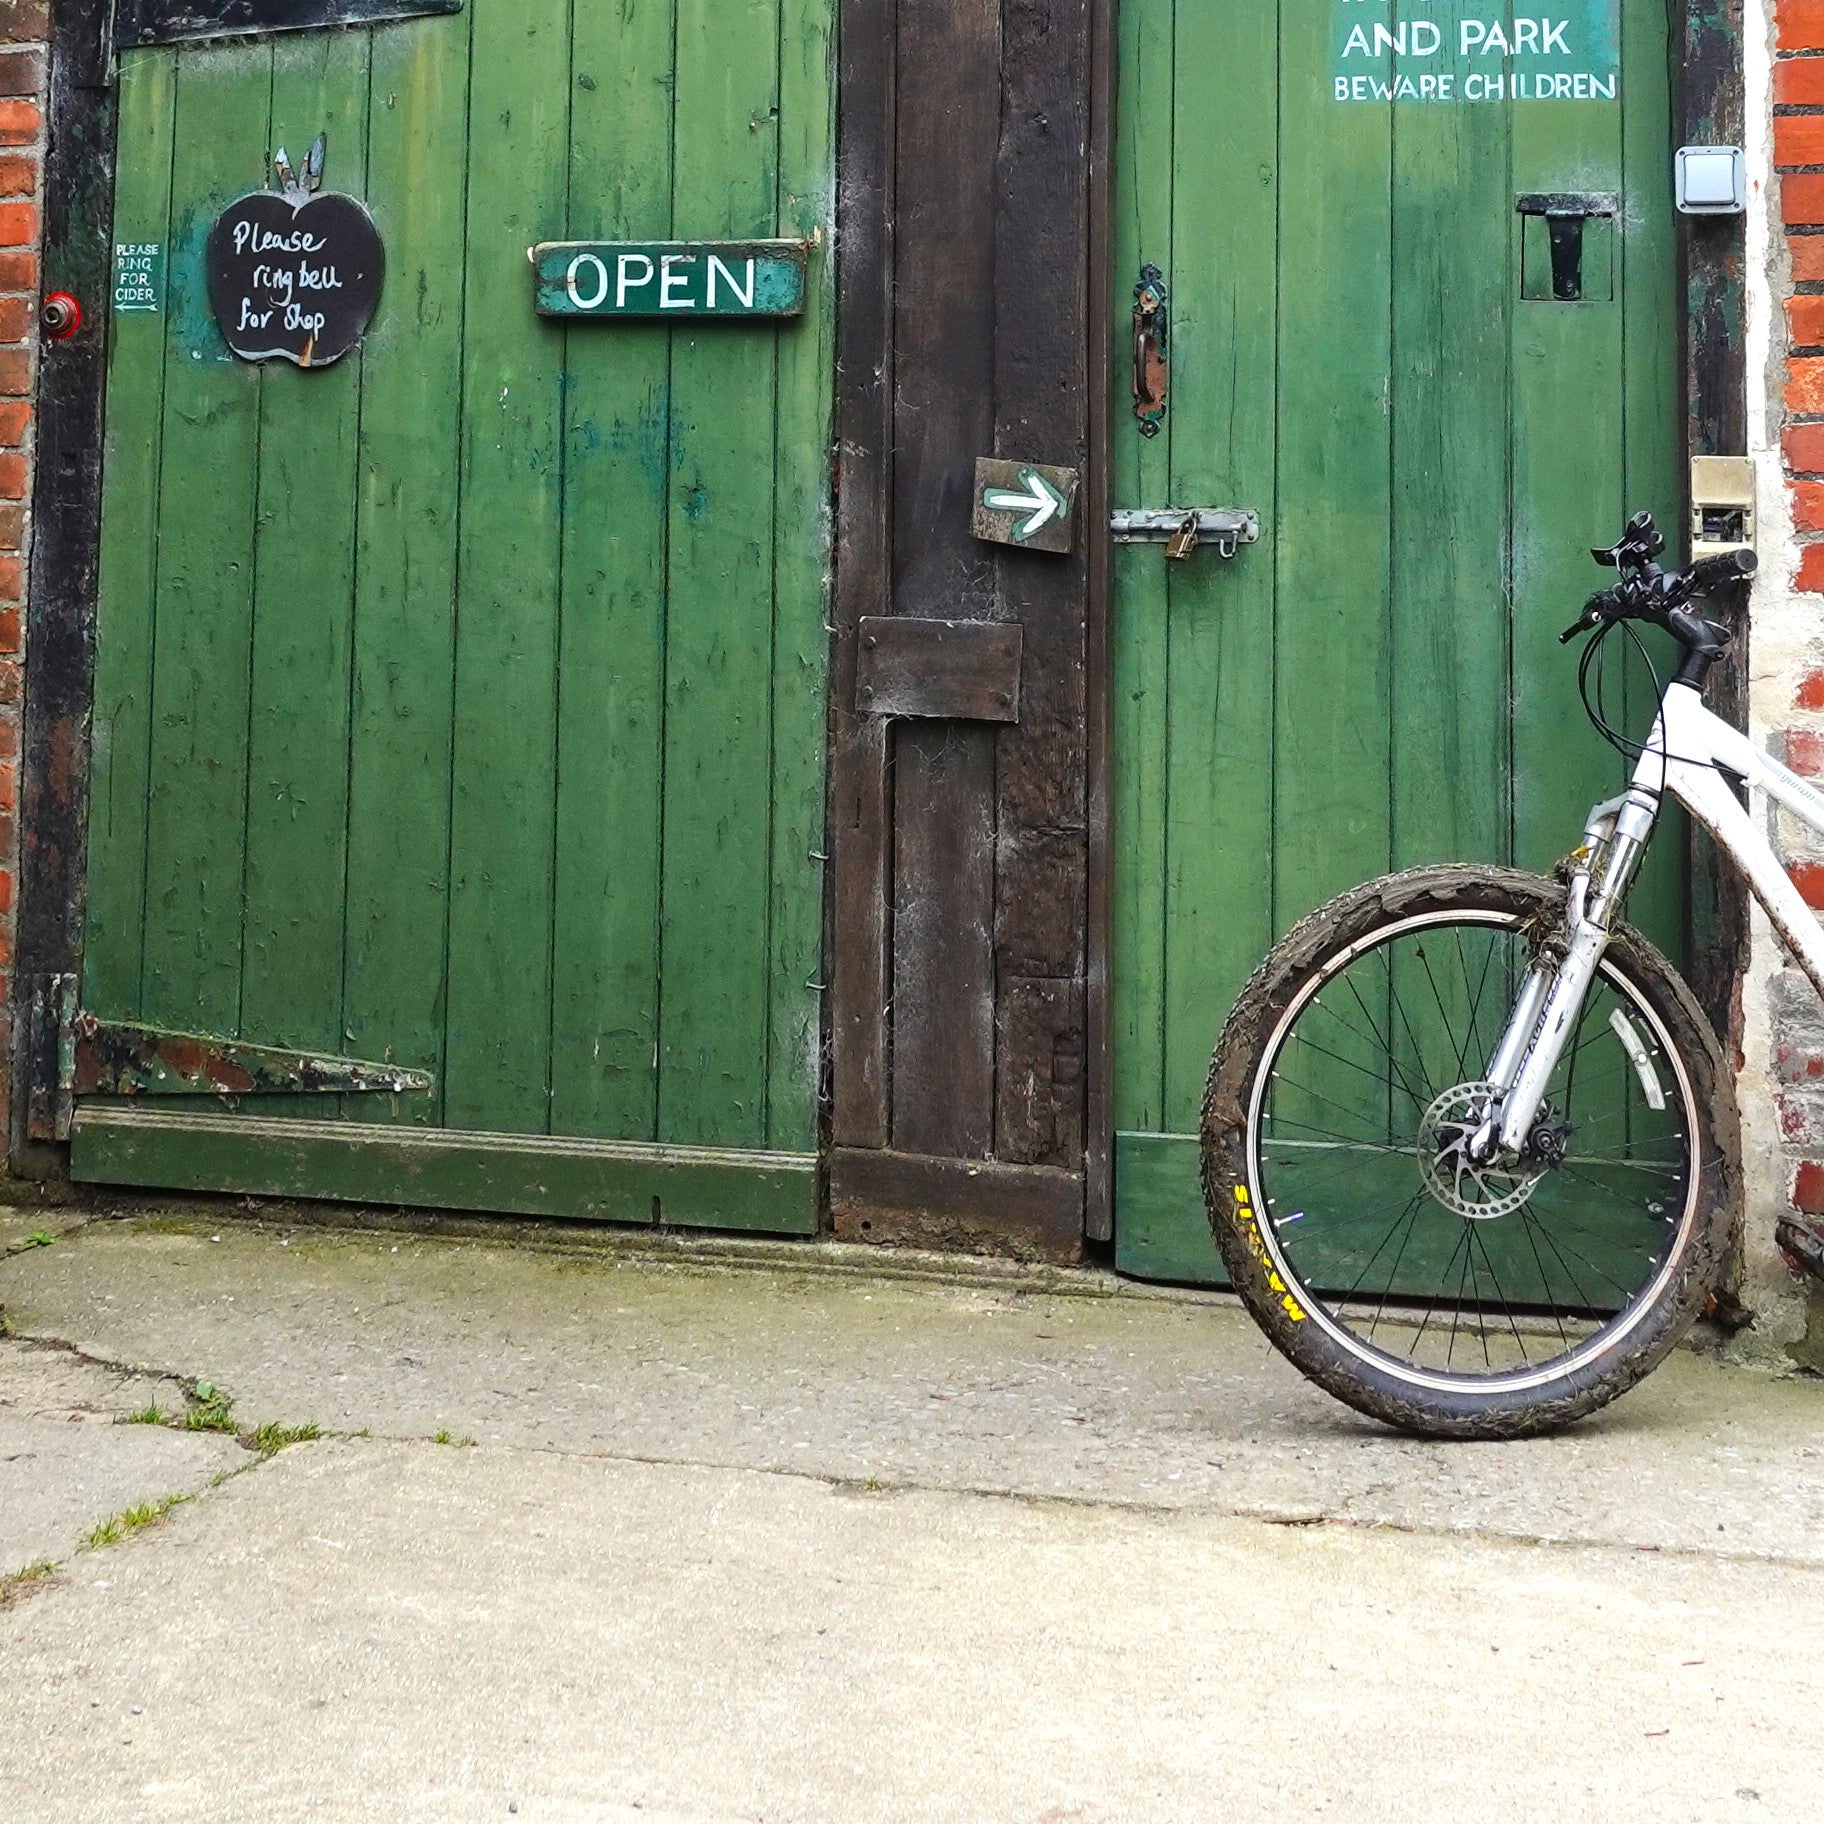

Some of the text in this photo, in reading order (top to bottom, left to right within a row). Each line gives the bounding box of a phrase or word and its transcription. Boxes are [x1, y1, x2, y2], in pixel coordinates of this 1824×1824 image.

[1341, 17, 1571, 58] AND PARK
[1334, 72, 1616, 101] BEWARE CHILDREN
[116, 244, 159, 256] PLEASE
[233, 221, 327, 255] Please
[117, 257, 153, 271] RING
[119, 272, 152, 286] FOR
[115, 287, 157, 302] CIDER
[253, 260, 343, 307] ring bell
[566, 253, 755, 309] OPEN
[236, 297, 274, 332] for
